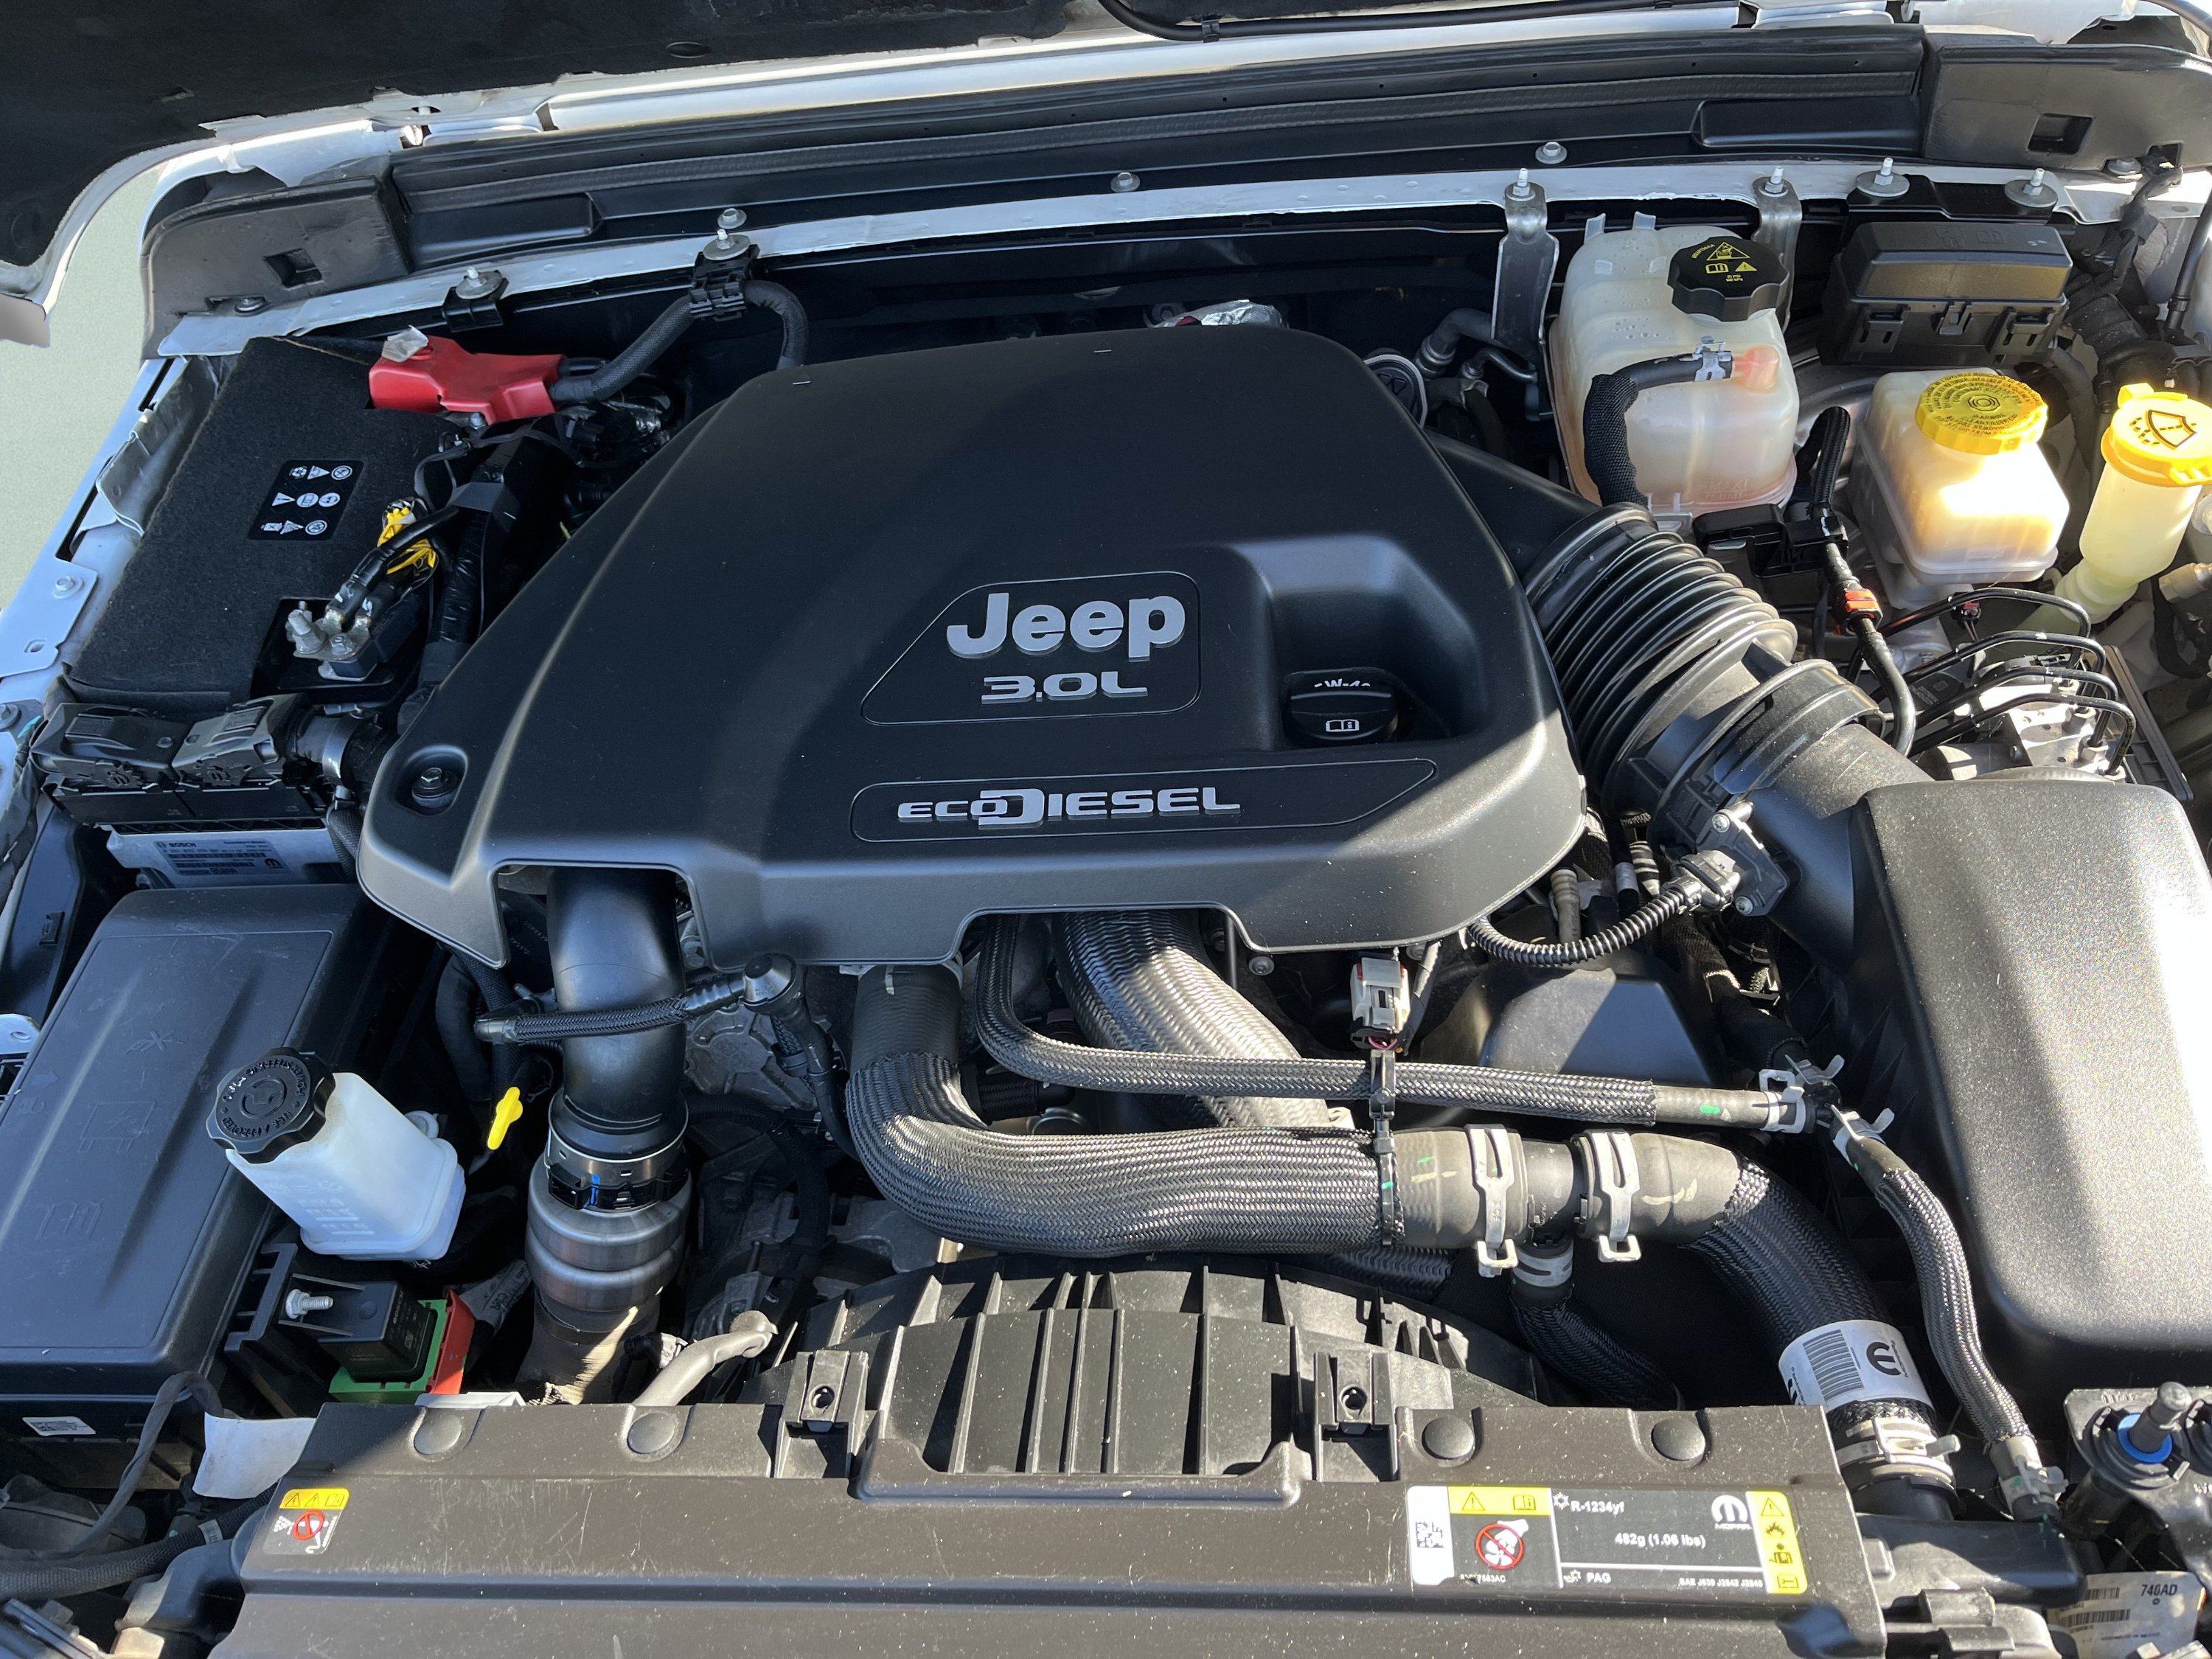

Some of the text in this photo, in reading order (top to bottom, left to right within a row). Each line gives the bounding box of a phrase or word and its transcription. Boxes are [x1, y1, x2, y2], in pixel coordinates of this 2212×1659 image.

[947, 593, 1185, 662] Jeep
[981, 671, 1148, 704] 3.0L
[1571, 1500, 1625, 1514] R-1234yf
[1681, 1534, 1706, 1548] lbs)
[1587, 1572, 1611, 1583] PAG
[2140, 1583, 2178, 1597] 740AD
